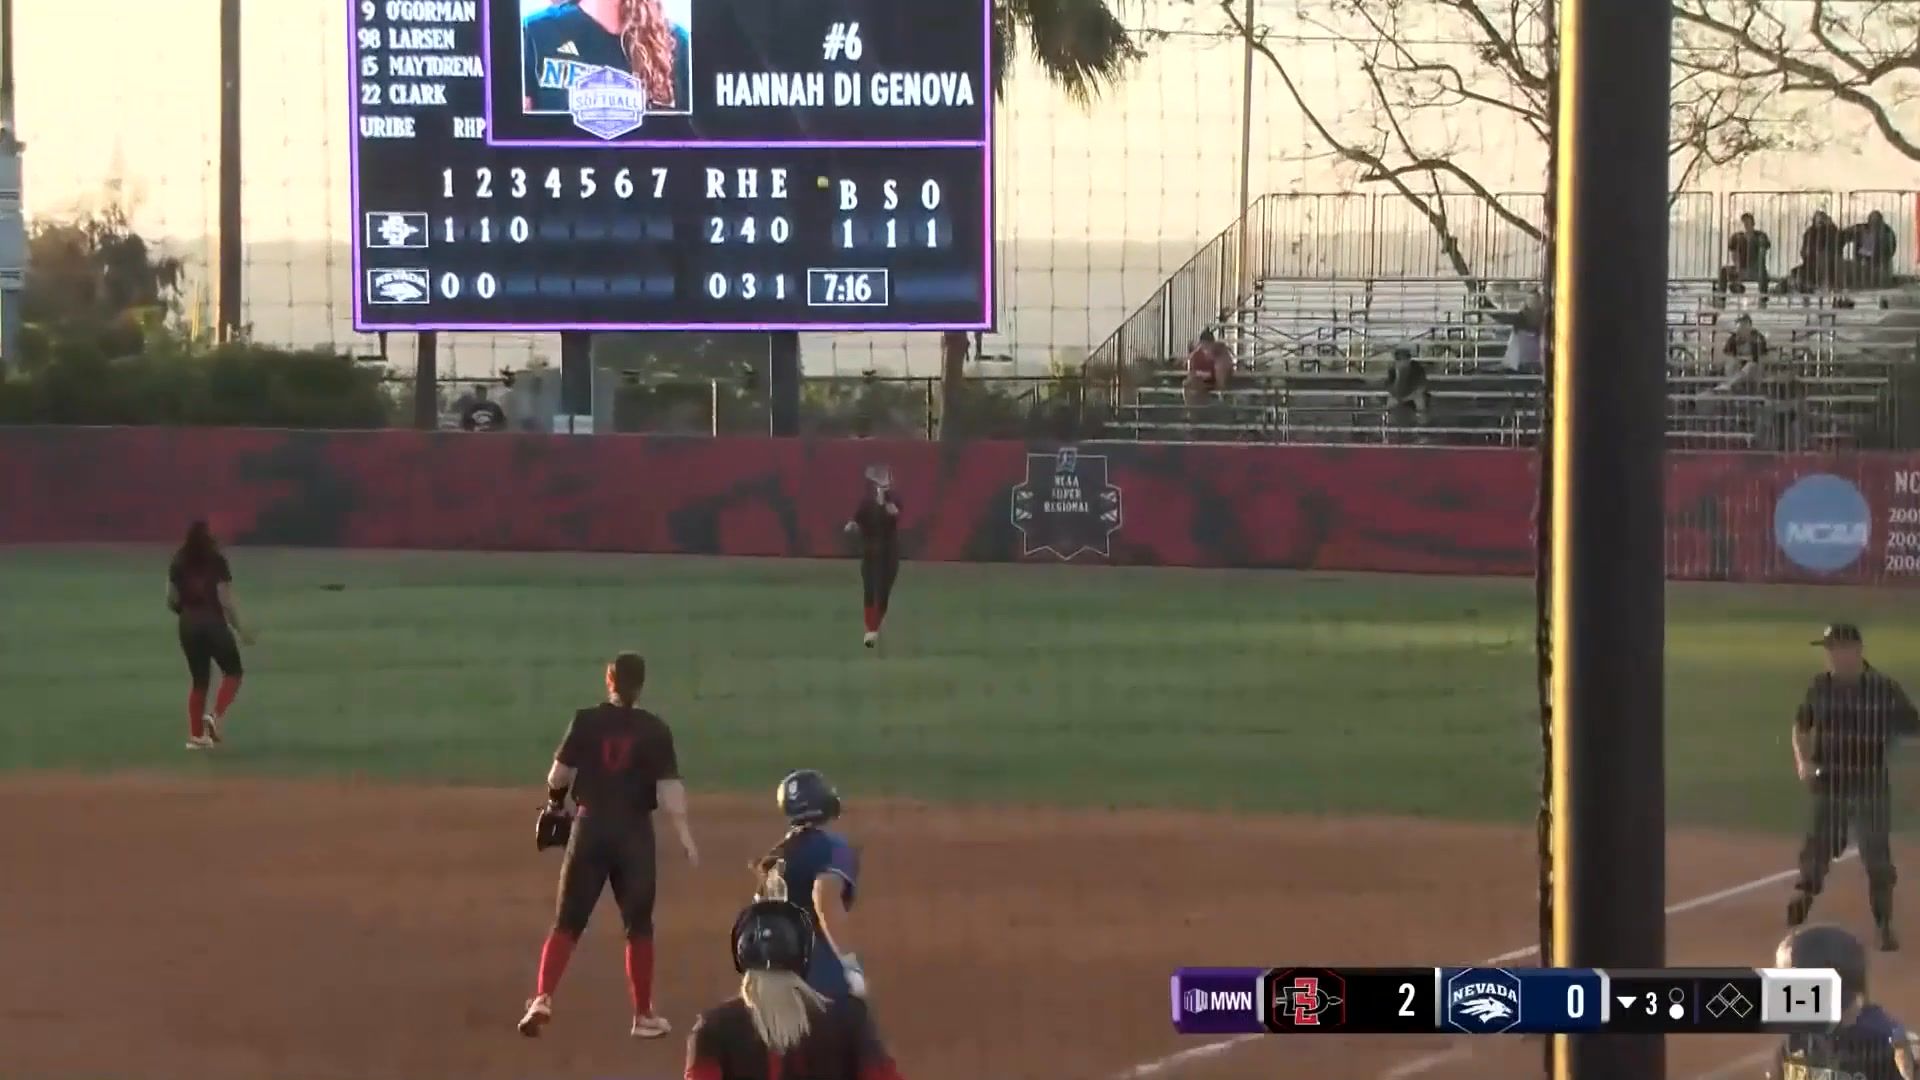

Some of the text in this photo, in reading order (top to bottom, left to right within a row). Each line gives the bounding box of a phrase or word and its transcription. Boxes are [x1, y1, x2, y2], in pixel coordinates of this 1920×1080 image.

[361, 0, 476, 21] 9 O'GORMAN
[358, 28, 455, 49] 98 LARSEN
[822, 21, 863, 61] #6
[361, 56, 484, 77] 15 MAYTORENA
[361, 84, 447, 104] 22 CLARK
[716, 72, 974, 106] HANNAH DI GENOVA
[360, 117, 486, 138] URIBE RHP
[443, 167, 668, 198] 1 2 3 4 5 6 7
[706, 168, 787, 198] R H E
[839, 179, 940, 210] B S O
[444, 217, 455, 243] 1
[480, 217, 491, 243] 1
[510, 216, 528, 243] 0
[710, 217, 789, 243] 2 4 0
[843, 218, 937, 248] 1 1 1
[441, 272, 496, 299] 0 0
[709, 273, 786, 299] 0 3 1
[824, 273, 872, 302] 7:16
[1044, 502, 1088, 513] REGIONAL
